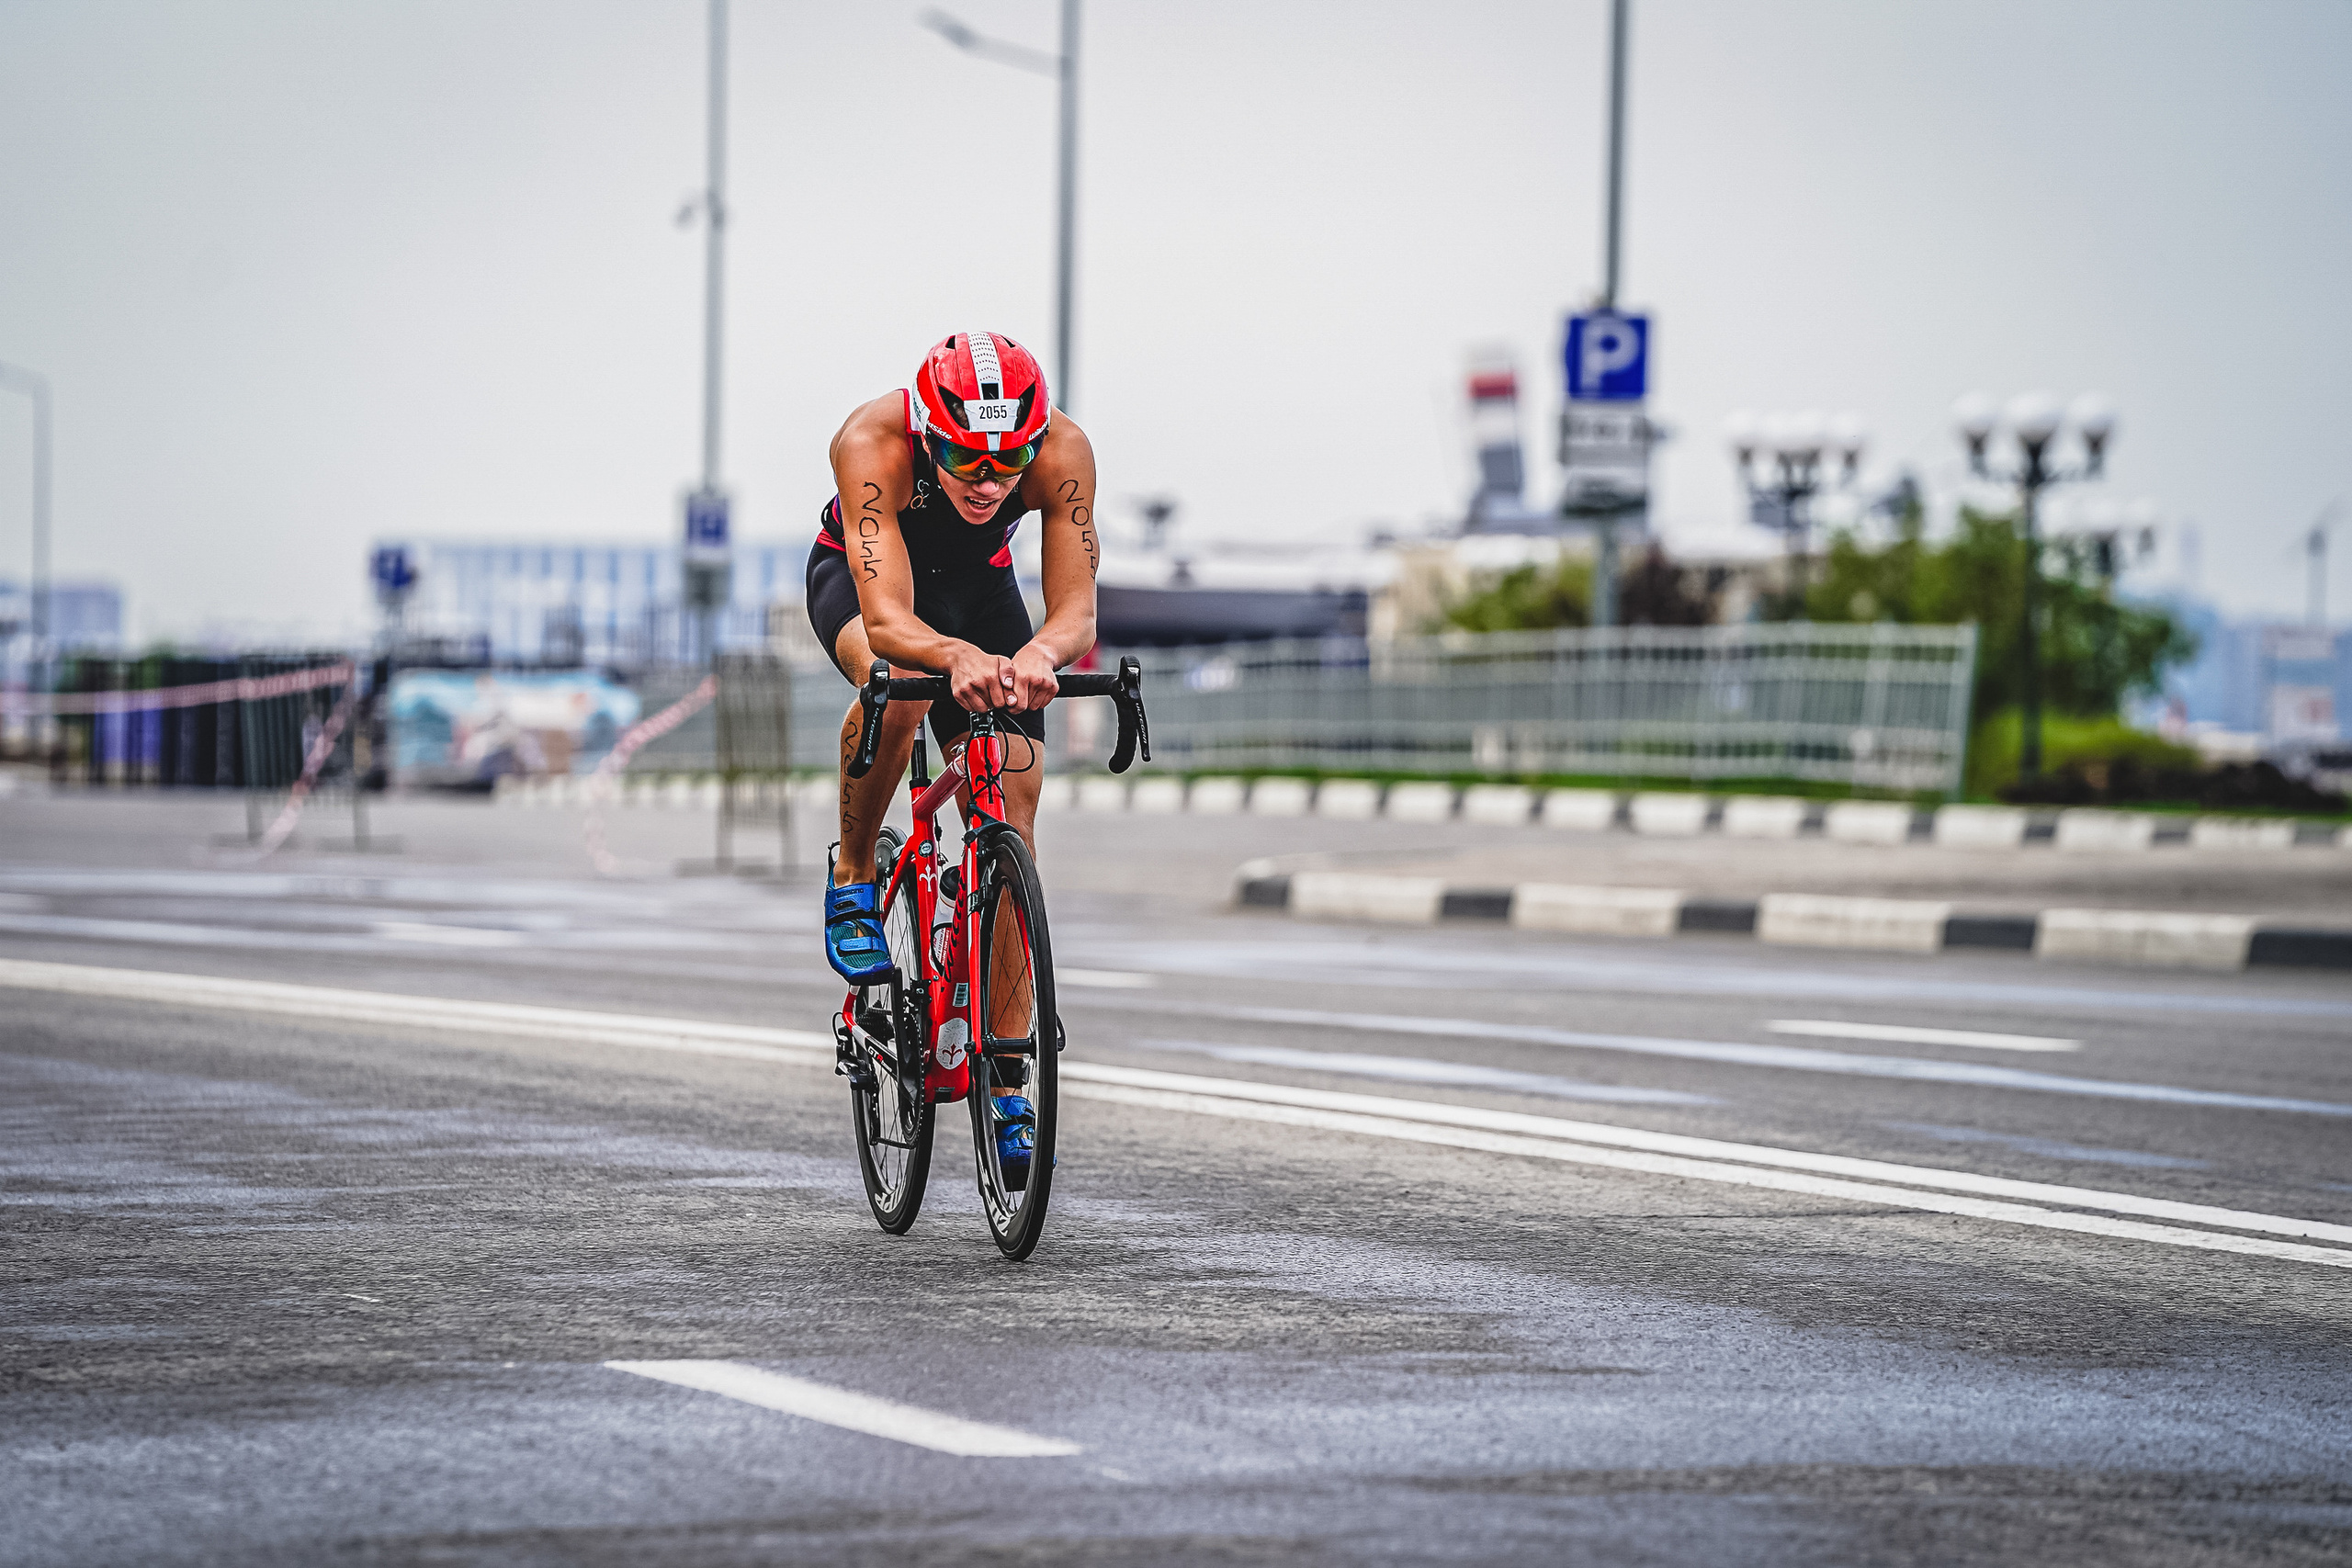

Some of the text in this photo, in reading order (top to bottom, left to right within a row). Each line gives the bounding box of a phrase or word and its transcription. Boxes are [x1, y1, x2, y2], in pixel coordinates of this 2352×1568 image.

[1579, 315, 1640, 390] P
[978, 405, 1008, 420] 2055
[859, 481, 883, 583] 2055
[1057, 479, 1096, 580] 2055
[867, 1046, 884, 1062] GTR
